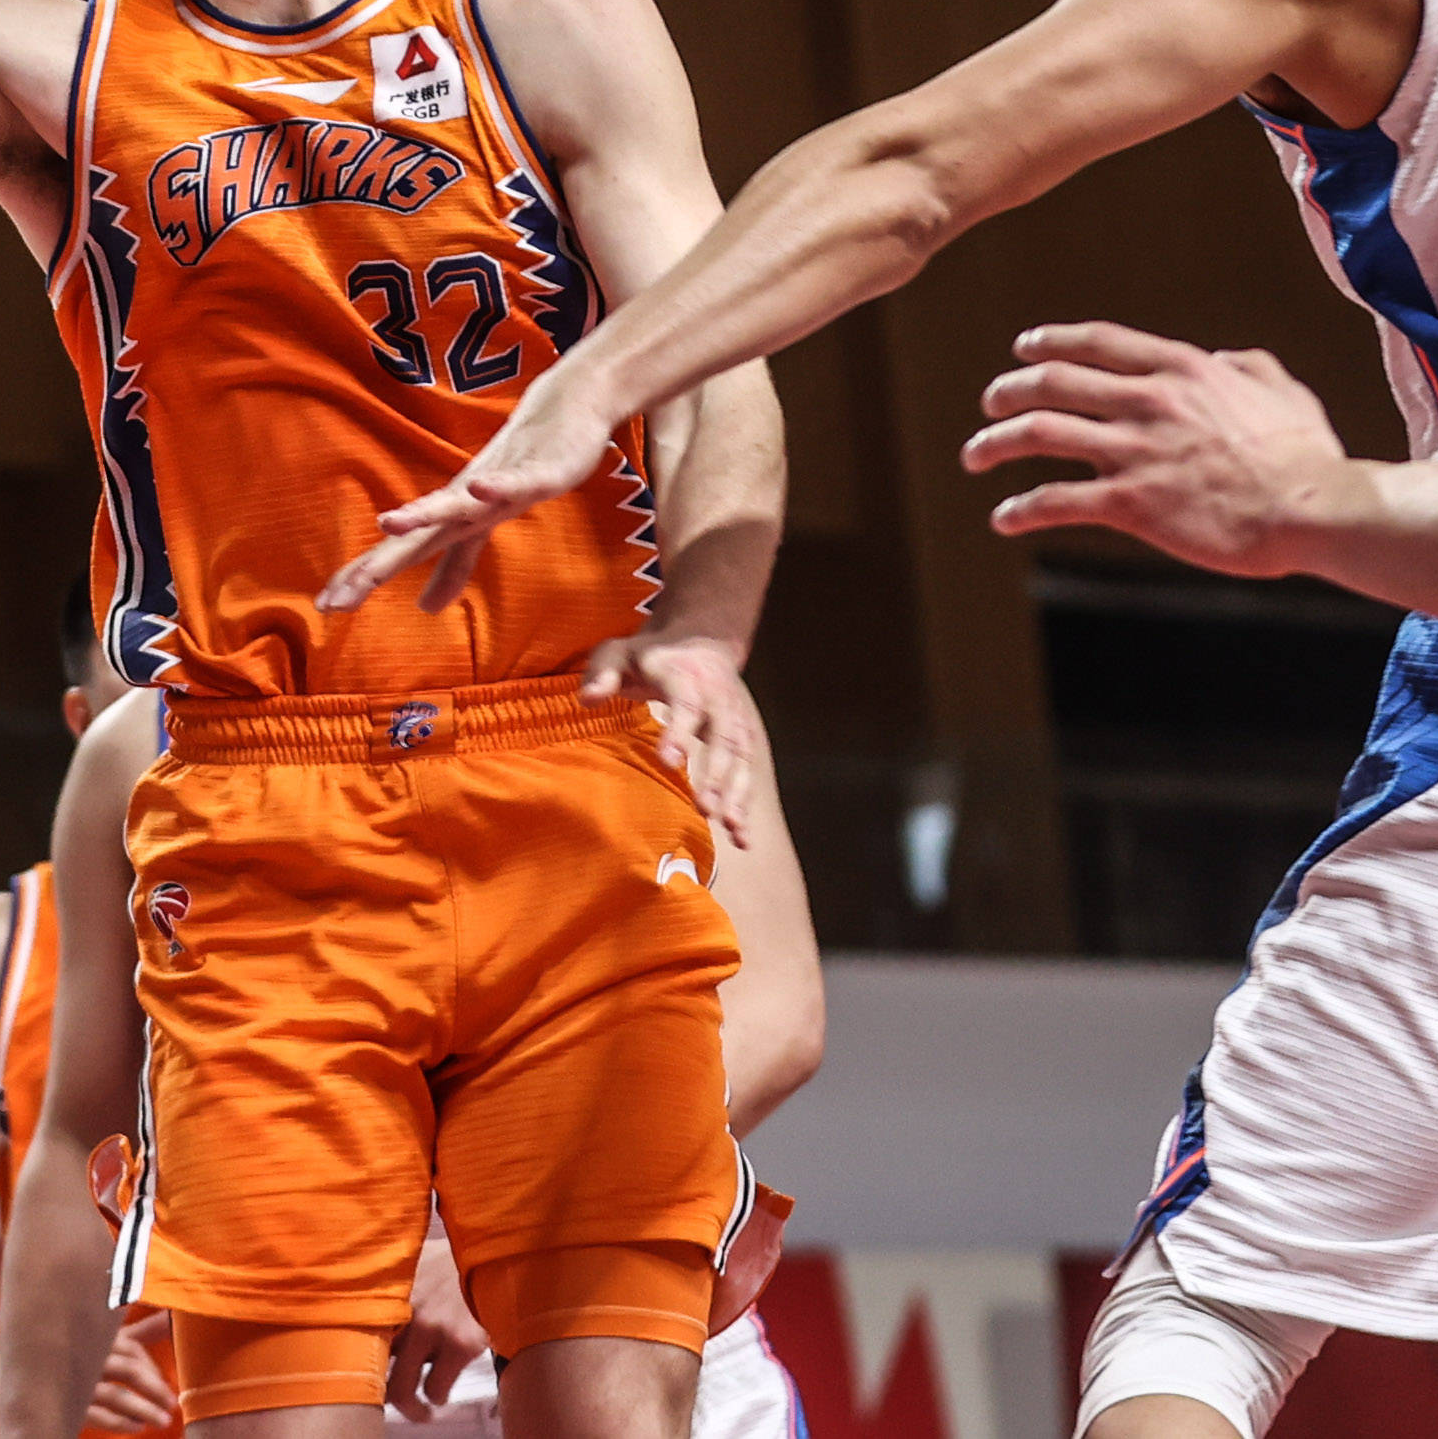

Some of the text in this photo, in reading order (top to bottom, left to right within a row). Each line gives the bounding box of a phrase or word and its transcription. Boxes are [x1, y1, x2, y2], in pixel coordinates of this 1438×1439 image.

[389, 79, 450, 104] 广发银行
[401, 103, 440, 119] CGB
[147, 117, 467, 267] SHARKS
[345, 251, 522, 394] 32
